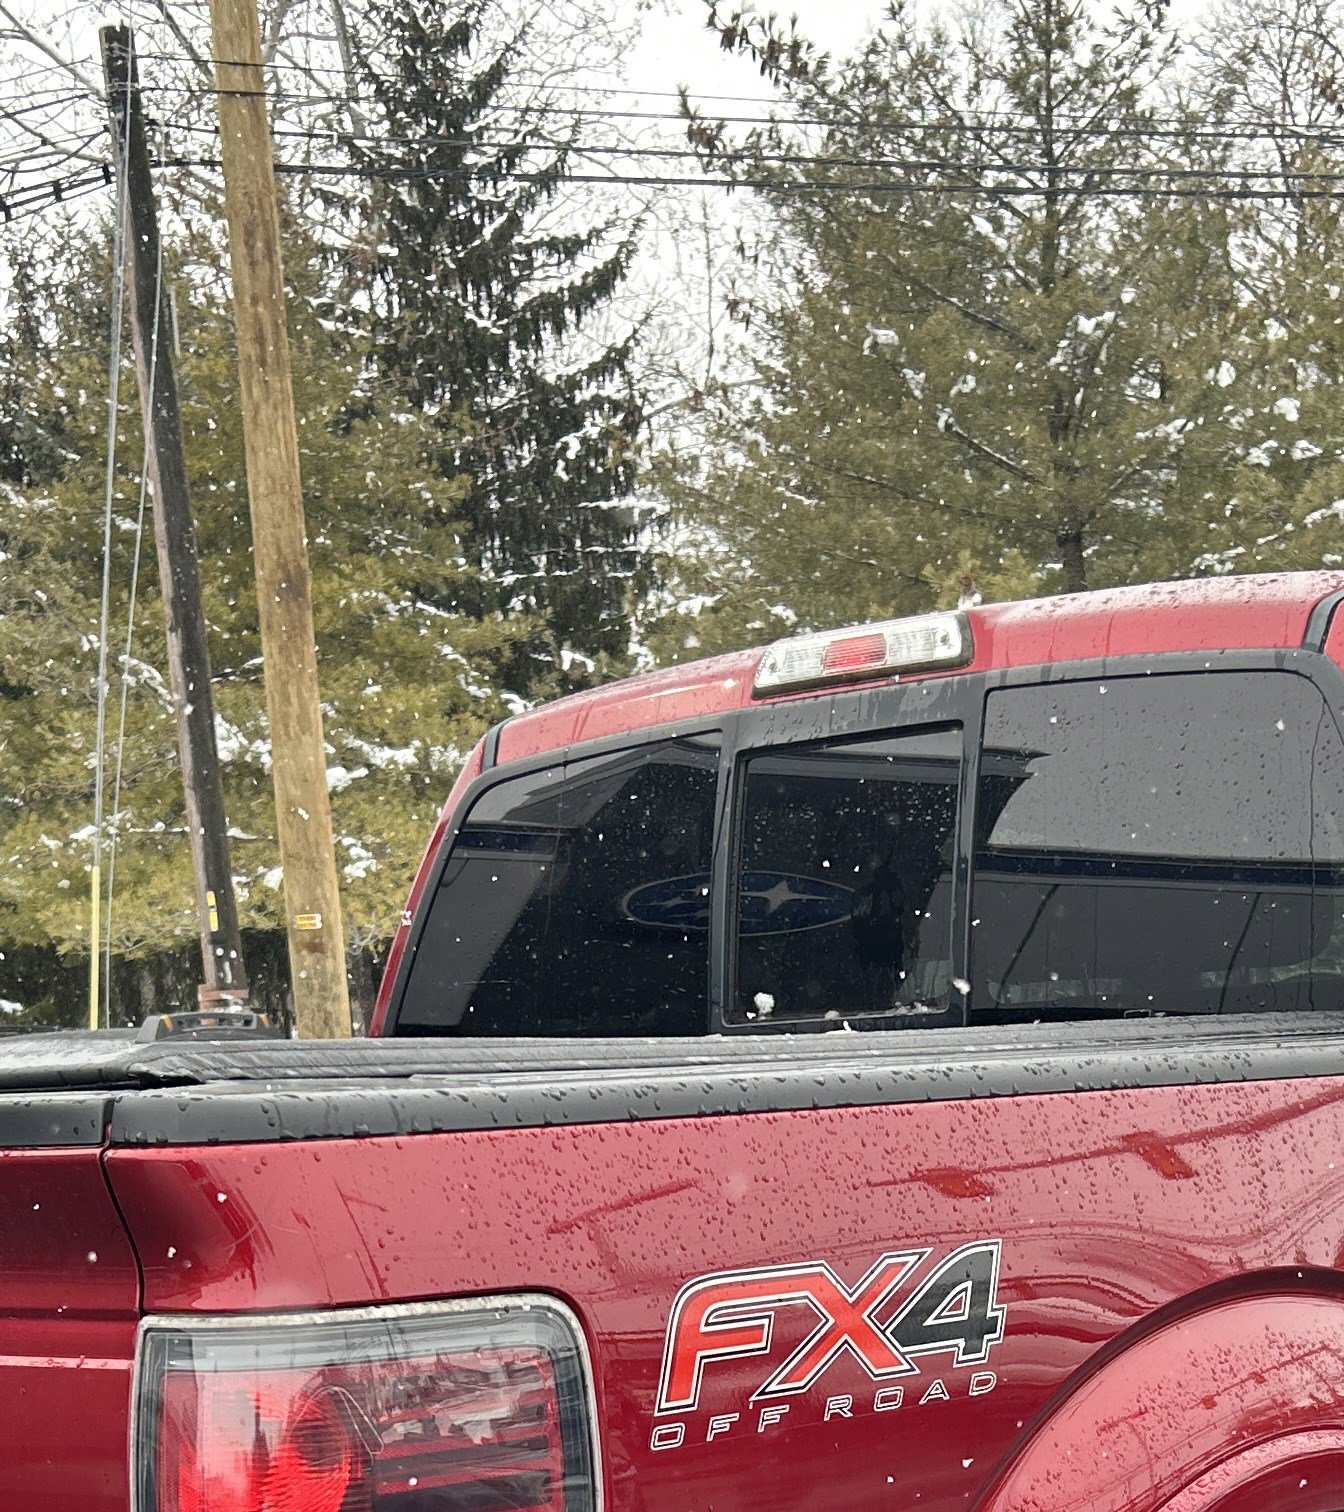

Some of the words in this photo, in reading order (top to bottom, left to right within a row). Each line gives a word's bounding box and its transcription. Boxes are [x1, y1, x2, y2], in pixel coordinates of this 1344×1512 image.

[654, 1238, 1007, 1416] FX4
[650, 1403, 790, 1451] OFF
[823, 1371, 996, 1422] ROAD
